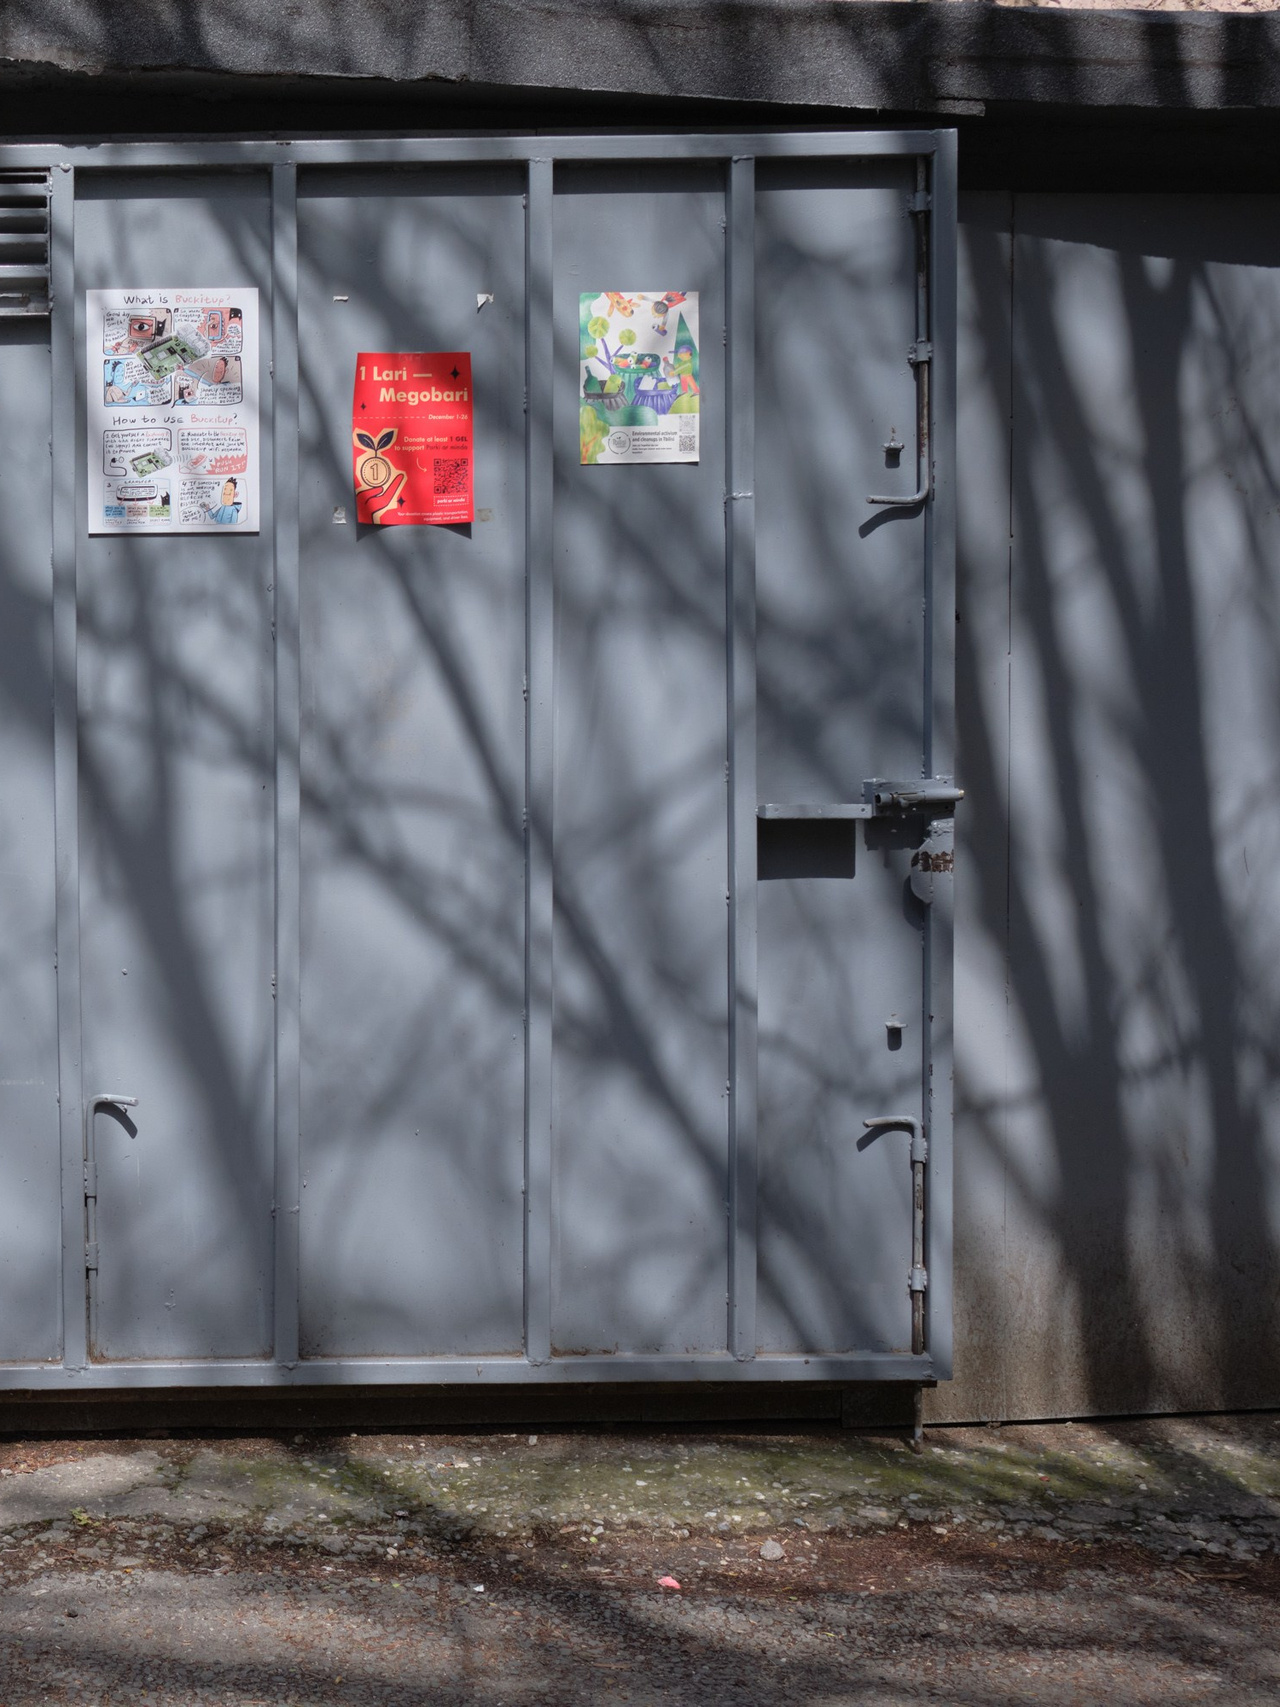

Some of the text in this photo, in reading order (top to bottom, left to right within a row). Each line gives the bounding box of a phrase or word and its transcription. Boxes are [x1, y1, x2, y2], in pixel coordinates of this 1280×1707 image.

[124, 294, 154, 304] What
[159, 293, 169, 304] is
[360, 366, 366, 381] 1
[373, 366, 407, 381] Lari
[379, 386, 468, 406] Megobari
[113, 416, 137, 426] How
[142, 415, 156, 423] to
[370, 463, 380, 481] 1
